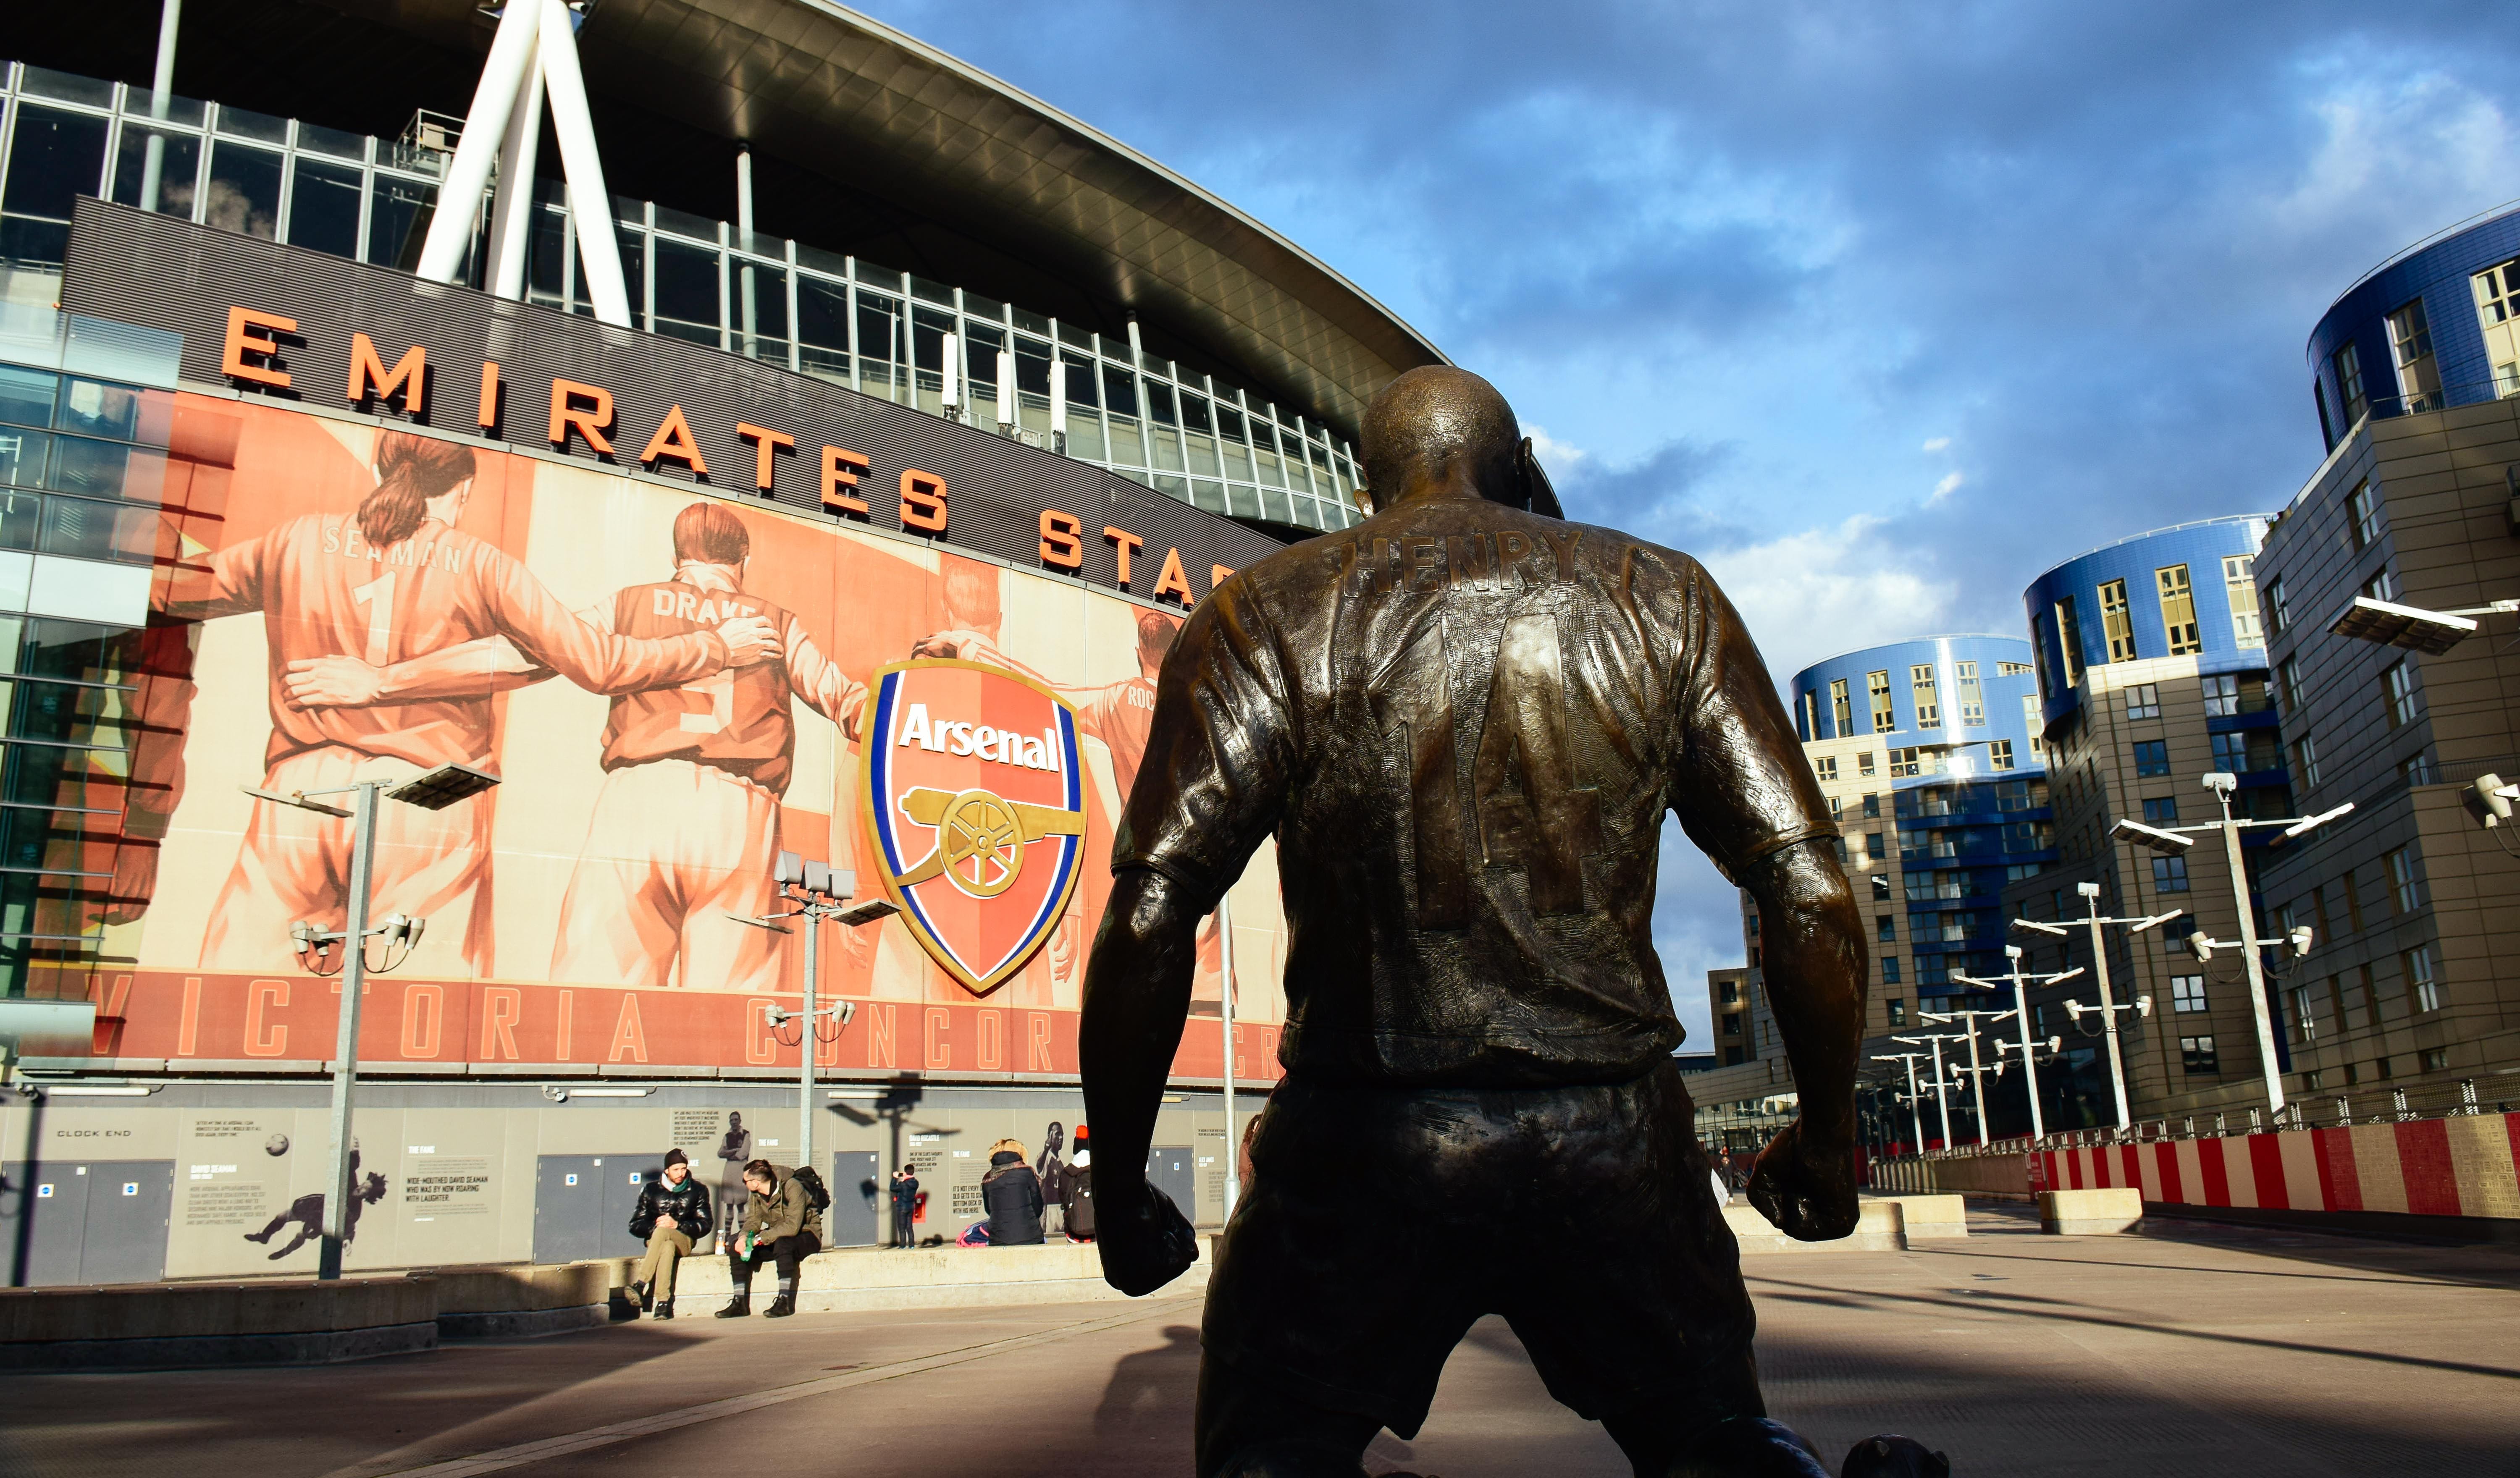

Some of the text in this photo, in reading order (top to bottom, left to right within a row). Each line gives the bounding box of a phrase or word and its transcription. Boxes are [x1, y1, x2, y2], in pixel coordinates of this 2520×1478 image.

[221, 306, 947, 532] EMIRATES
[323, 527, 462, 575] SEAMAN
[1341, 530, 1583, 598] HENRY
[352, 569, 396, 667] 1
[898, 702, 1059, 773] Arsenal
[1367, 612, 1605, 933] 14
[746, 998, 1175, 1075] CONCOR
[408, 1145, 435, 1154] THE FANS
